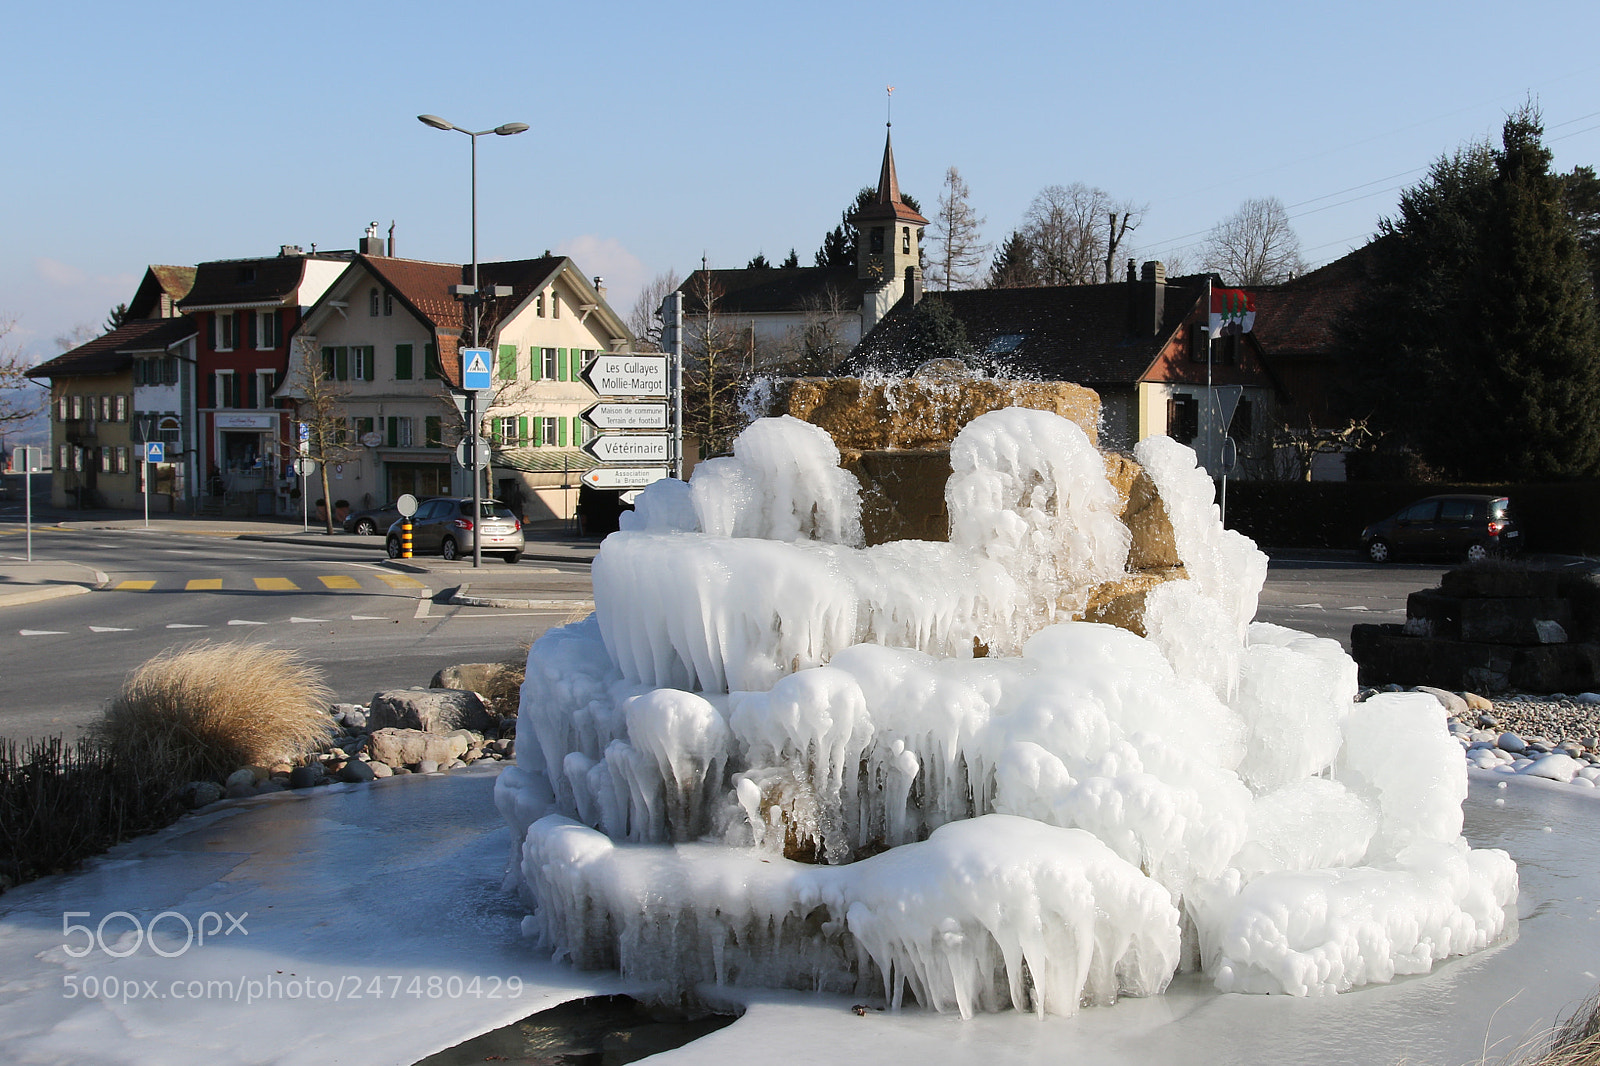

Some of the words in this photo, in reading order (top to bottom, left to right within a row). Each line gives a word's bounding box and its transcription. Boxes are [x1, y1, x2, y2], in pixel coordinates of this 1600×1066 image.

[606, 362, 620, 374] Les
[624, 362, 659, 377] Cullayes
[602, 378, 663, 392] Mollie-Margot
[601, 407, 622, 415] Maison
[625, 407, 632, 415] de
[605, 443, 664, 454] Vétérinaire
